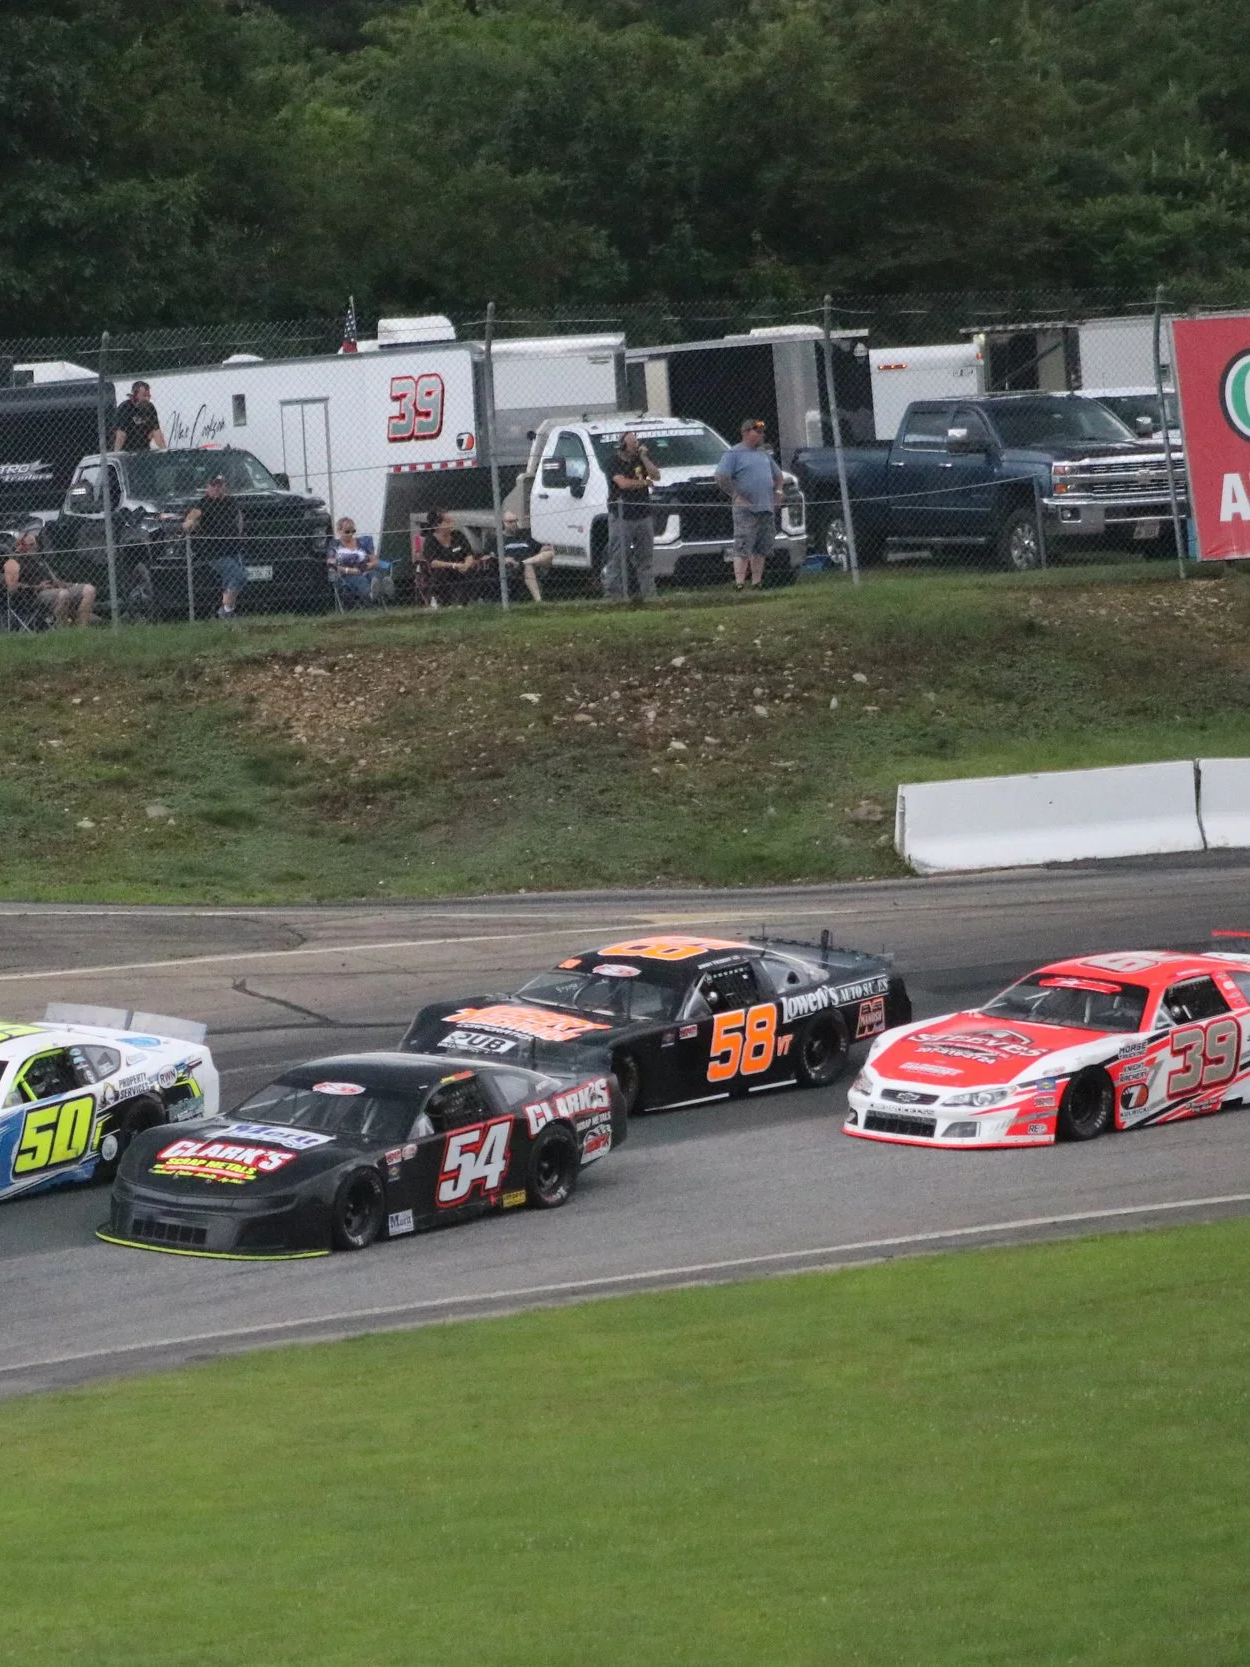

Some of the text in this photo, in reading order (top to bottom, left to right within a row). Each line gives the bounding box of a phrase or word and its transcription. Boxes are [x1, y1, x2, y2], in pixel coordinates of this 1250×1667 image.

[387, 372, 445, 443] 39
[1219, 472, 1250, 522] A
[707, 1002, 794, 1083] 58 VT
[1119, 1041, 1148, 1055] MORSE
[1165, 1015, 1243, 1102] 39
[118, 1072, 147, 1089] PROPERTY
[120, 1082, 152, 1100] SERVICES
[159, 1069, 177, 1084] RWN
[524, 1078, 610, 1136] CLARK'S
[13, 1095, 95, 1174] 50
[159, 1139, 295, 1171] CLARK'S
[165, 1157, 207, 1167] SCRAP
[205, 1160, 258, 1175] METALS
[436, 1116, 512, 1207] 54
